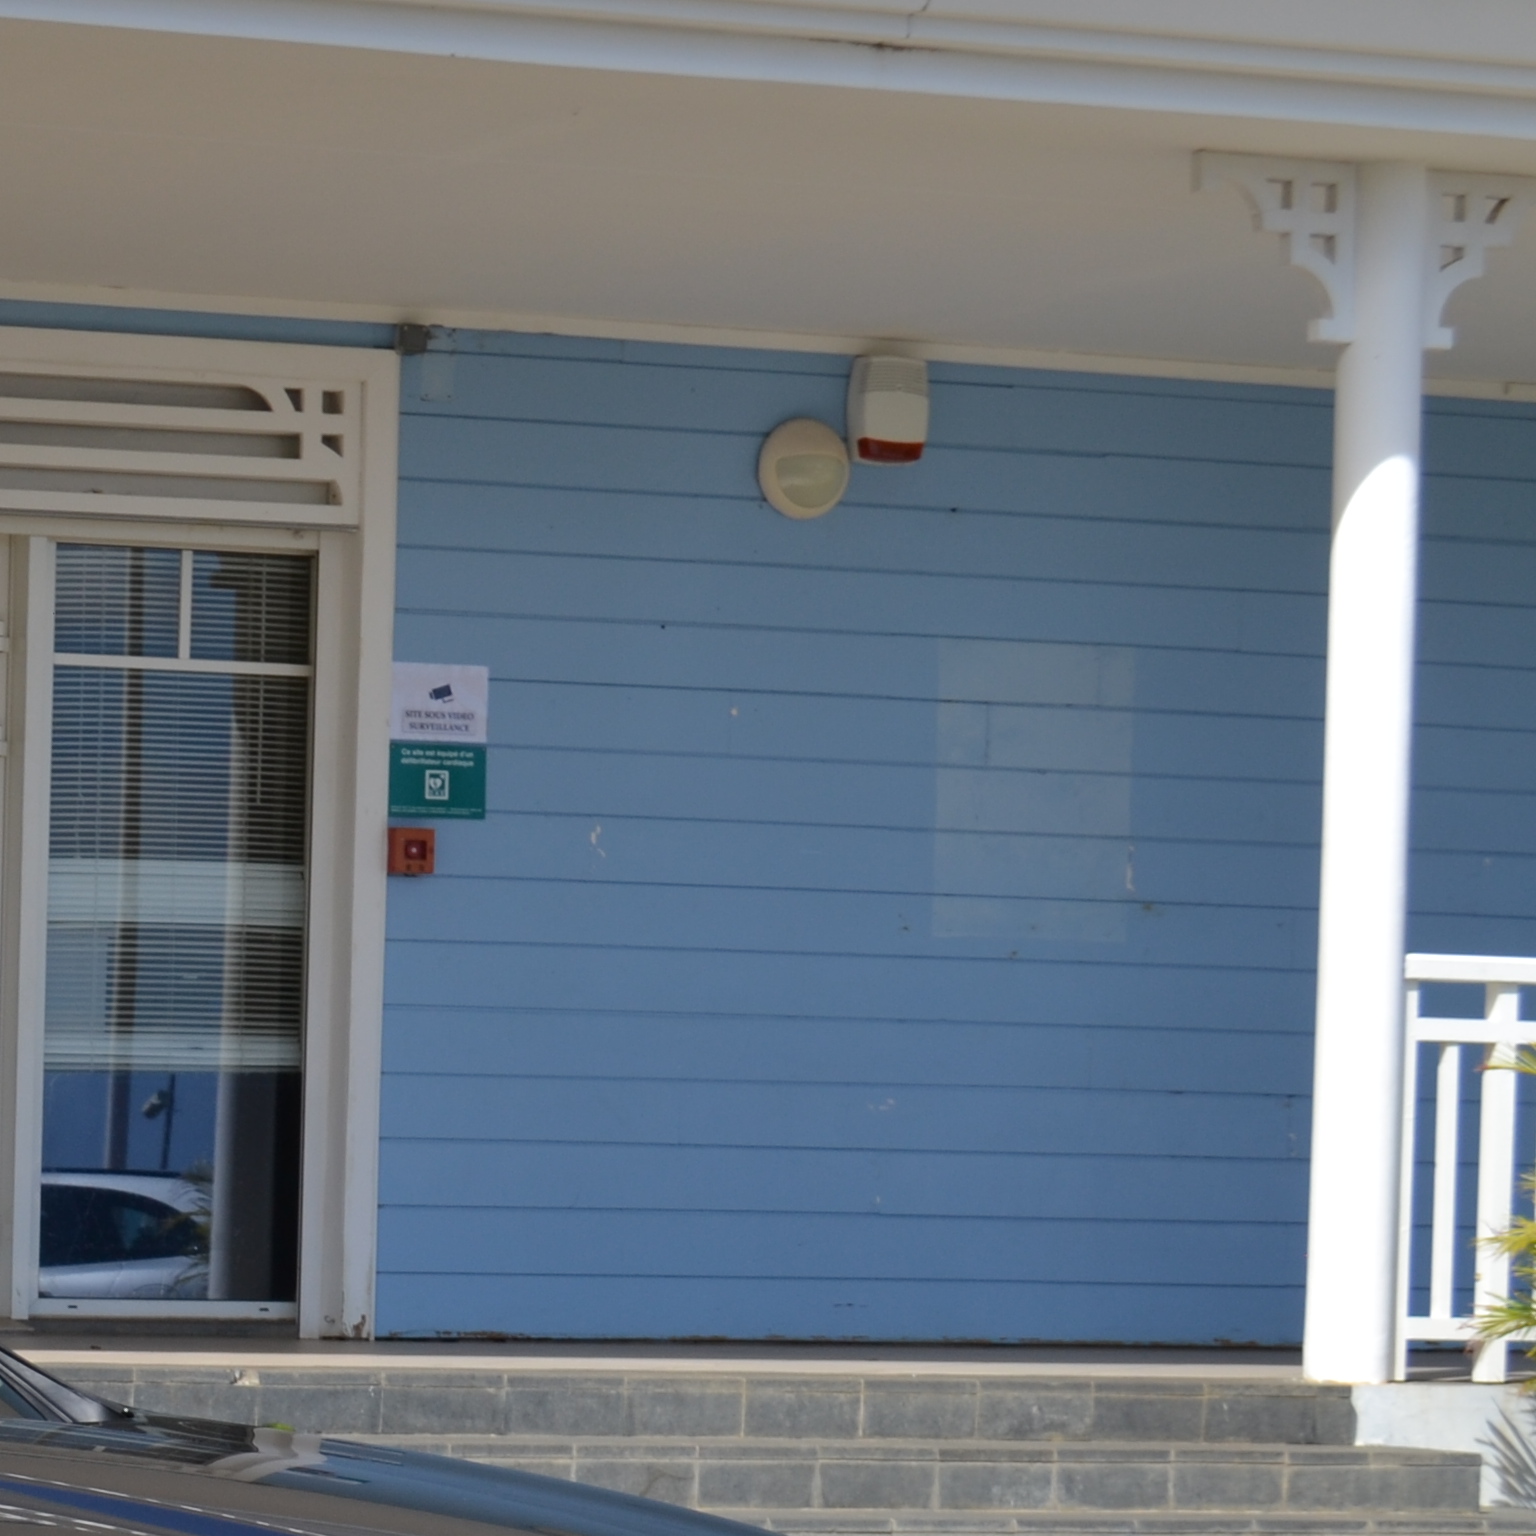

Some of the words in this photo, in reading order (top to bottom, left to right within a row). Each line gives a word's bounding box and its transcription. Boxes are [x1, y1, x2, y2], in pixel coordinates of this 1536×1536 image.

[405, 710, 423, 719] SITE
[424, 711, 446, 720] SOUS
[447, 711, 475, 721] VIDEO
[408, 722, 469, 732] SURVEILLANCE
